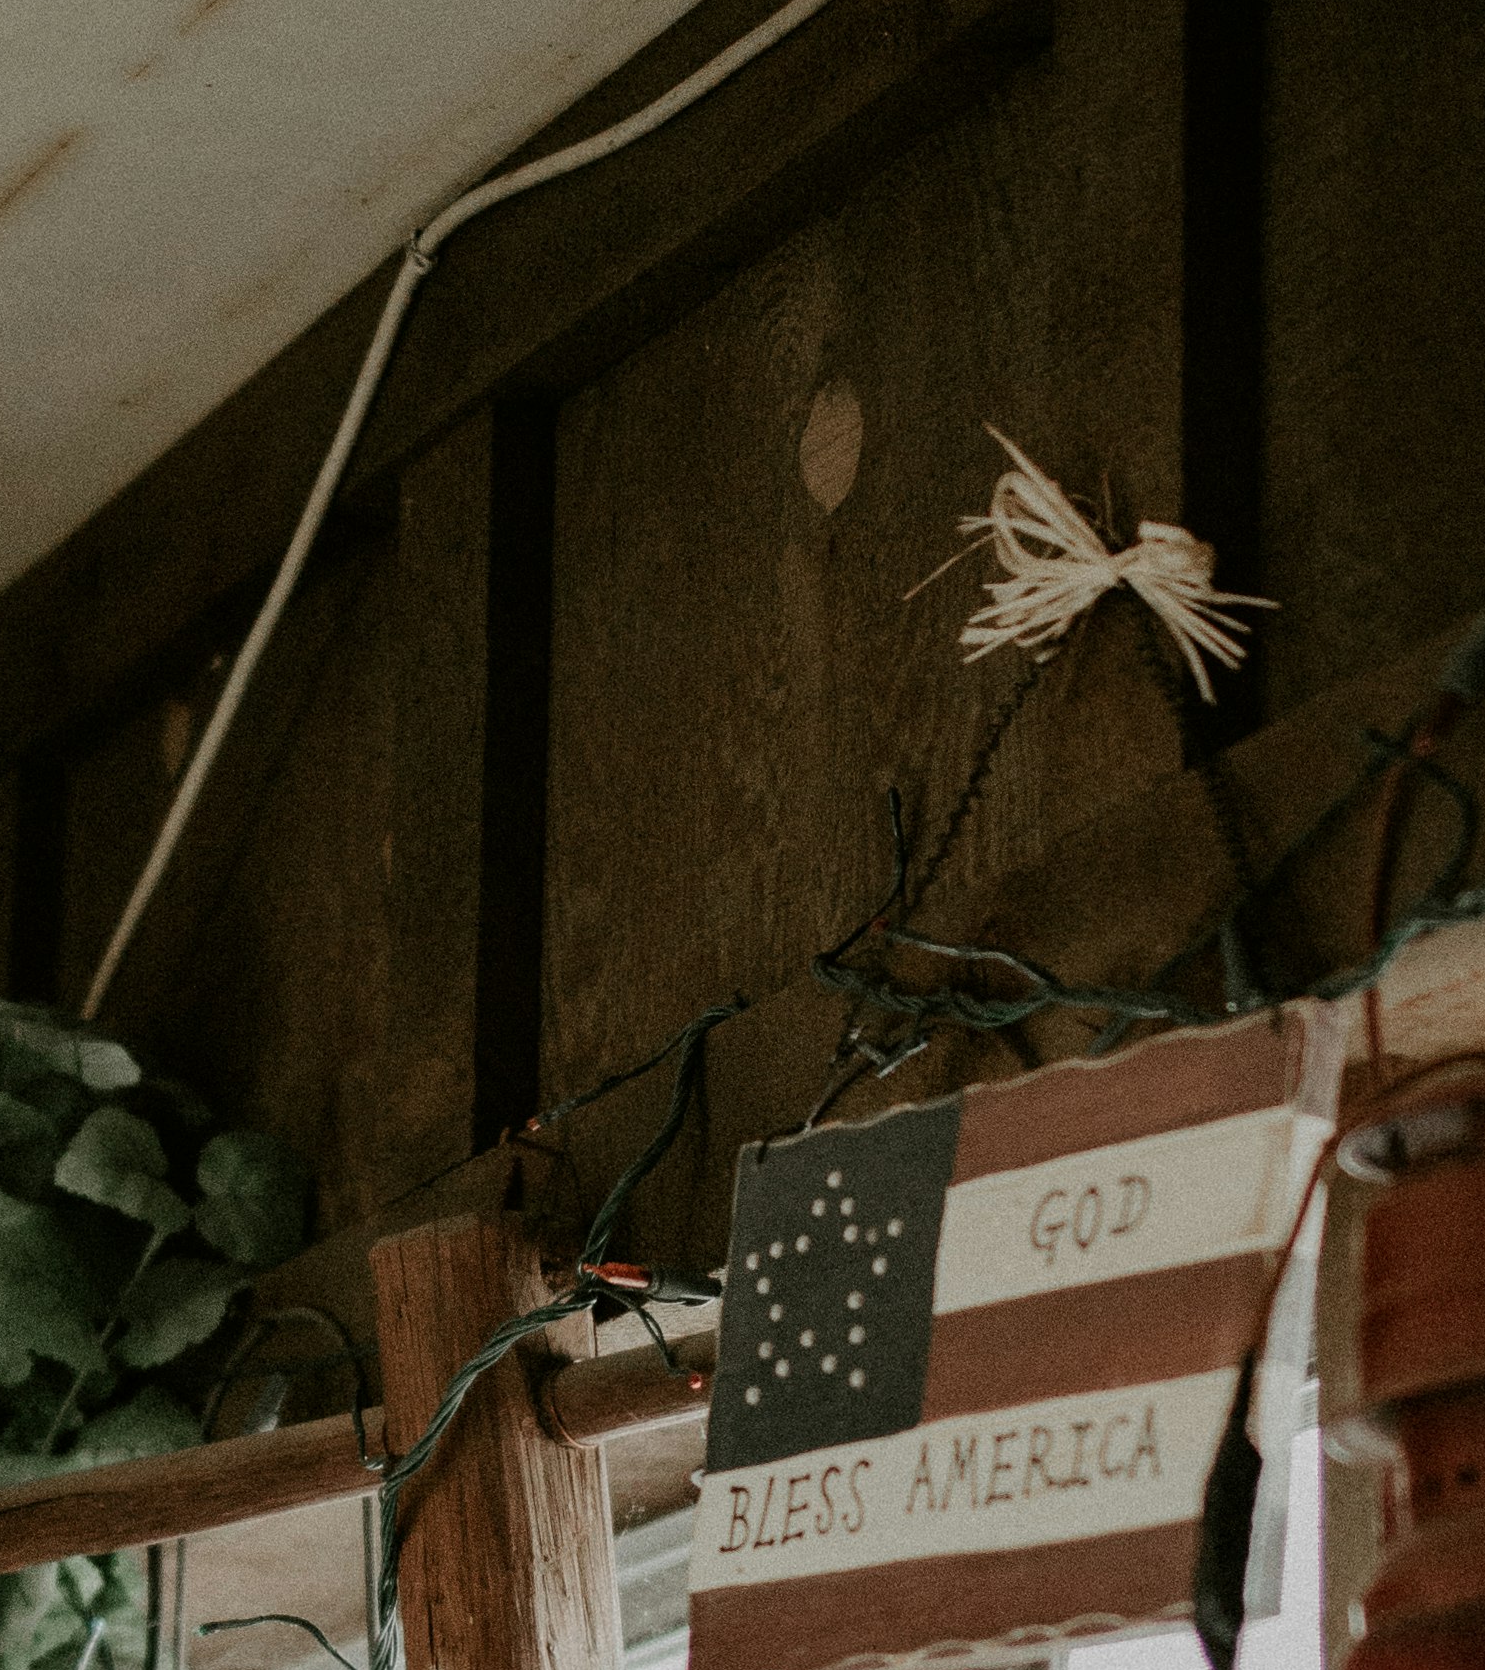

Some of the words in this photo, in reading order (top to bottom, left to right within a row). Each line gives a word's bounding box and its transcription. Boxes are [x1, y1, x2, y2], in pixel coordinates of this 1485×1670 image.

[1029, 1175, 1152, 1266] GOD
[718, 1458, 872, 1553] BLESS
[905, 1404, 1163, 1514] AMERICA
